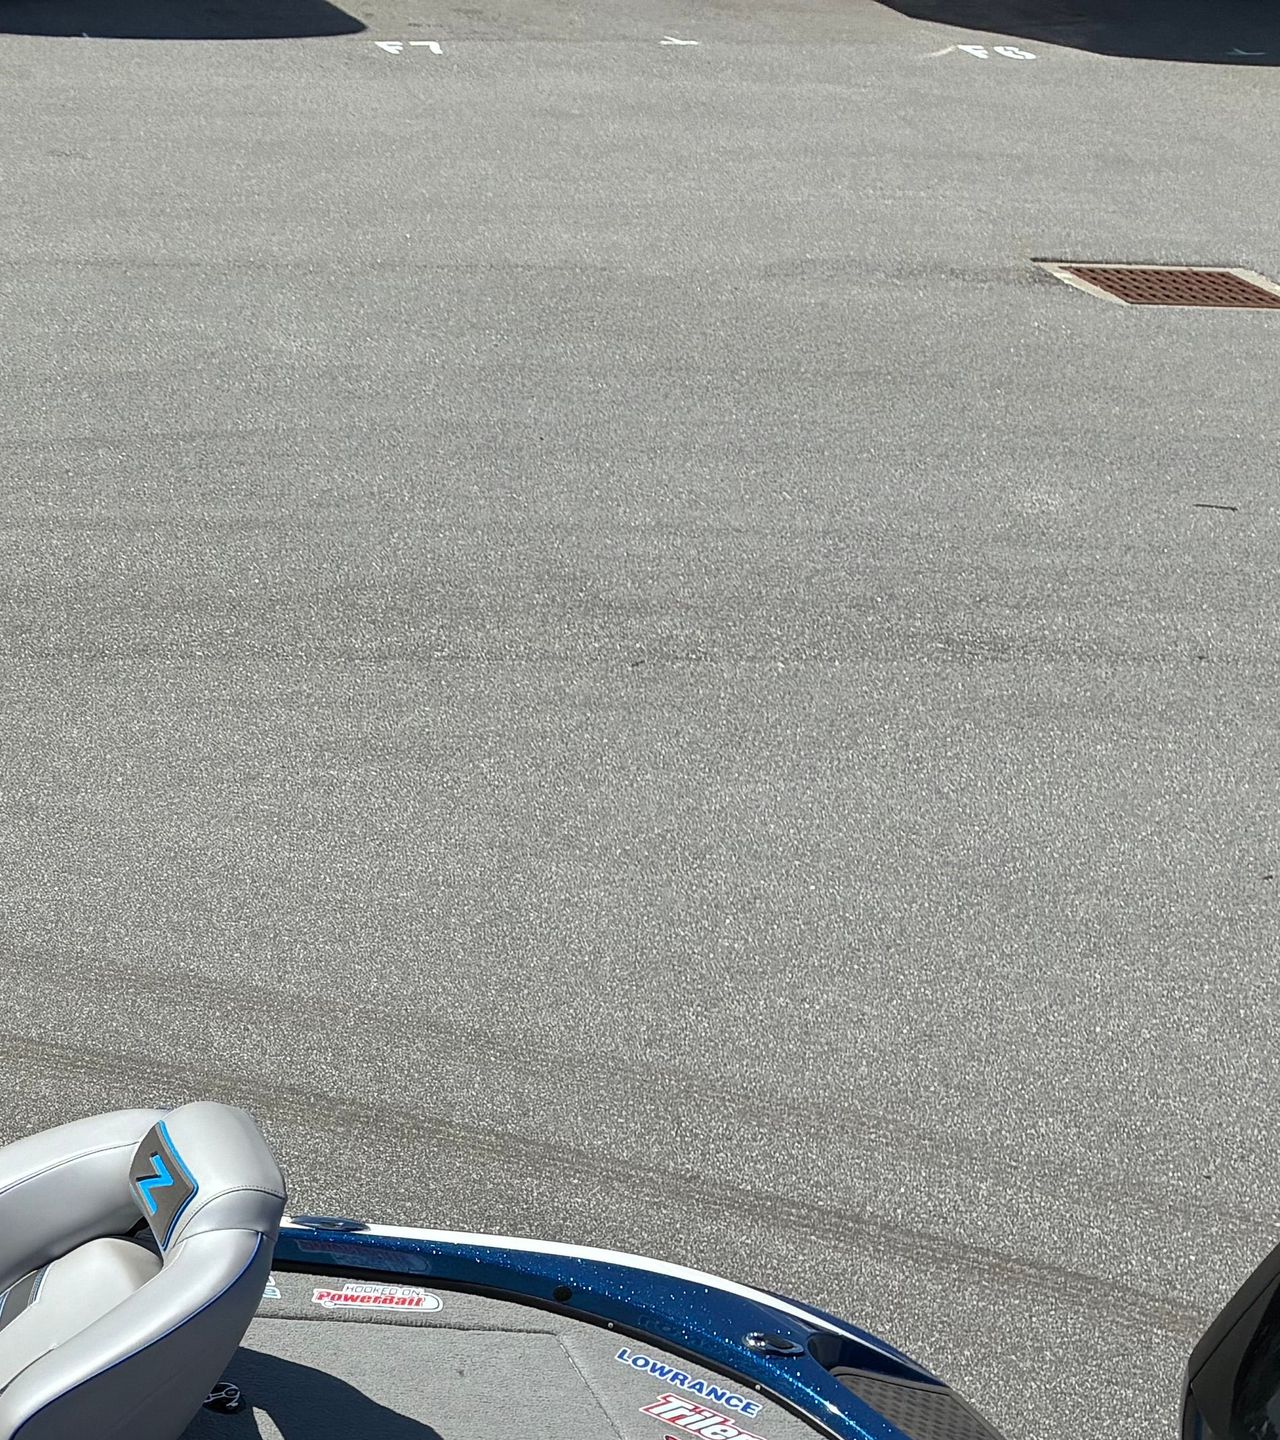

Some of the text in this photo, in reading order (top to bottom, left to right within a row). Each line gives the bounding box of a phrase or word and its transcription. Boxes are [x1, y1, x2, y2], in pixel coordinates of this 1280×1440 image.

[374, 41, 443, 55] F7
[344, 1286, 399, 1296] HOOKED
[316, 1291, 425, 1307] PowerBait
[617, 1349, 761, 1416] LOWRANCE
